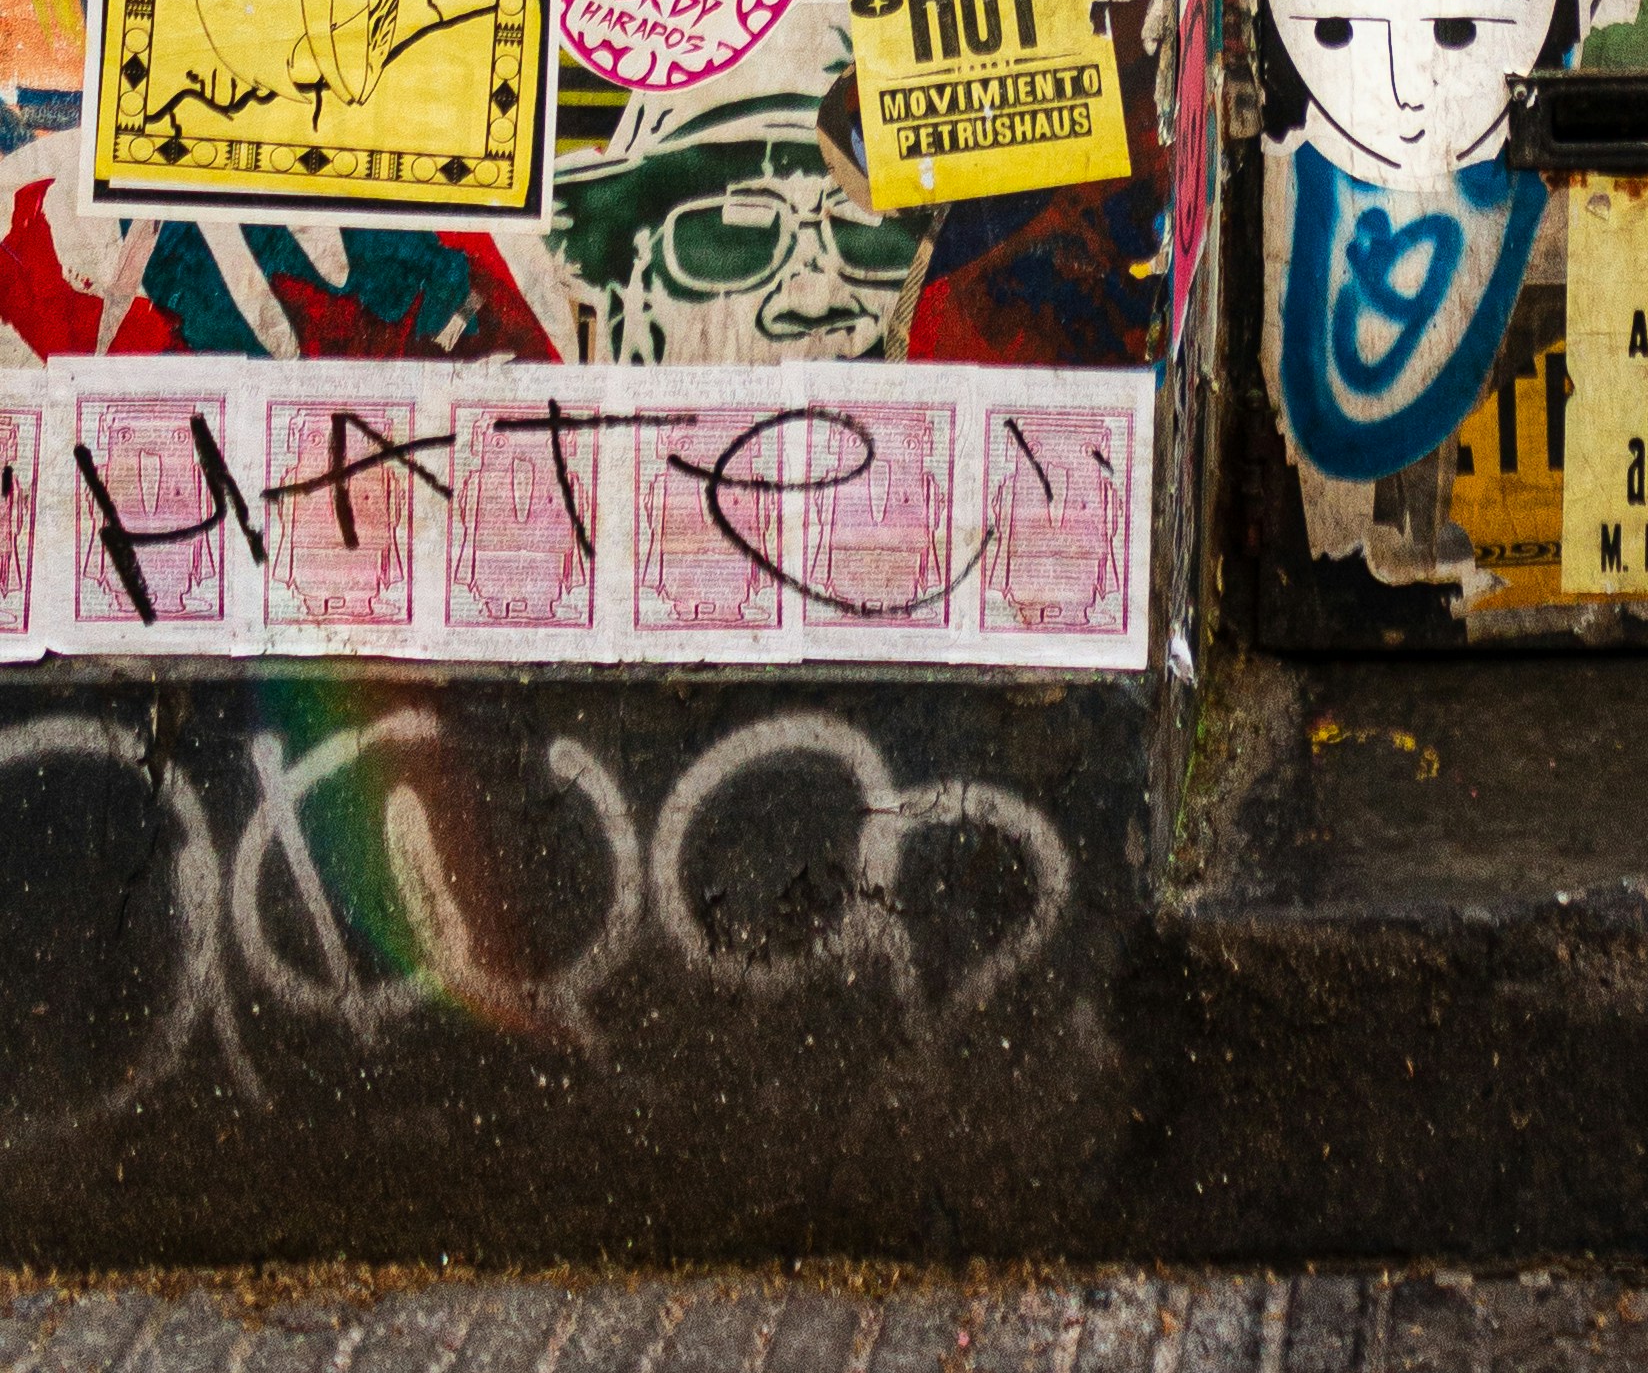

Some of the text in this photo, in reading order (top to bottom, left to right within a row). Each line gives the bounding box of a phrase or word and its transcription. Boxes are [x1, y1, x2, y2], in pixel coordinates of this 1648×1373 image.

[579, 1, 705, 54] HARAPOS
[882, 67, 1100, 122] MOVIMIENTO
[898, 104, 1090, 158] PETRUSHAUS
[1601, 525, 1628, 573] M.
